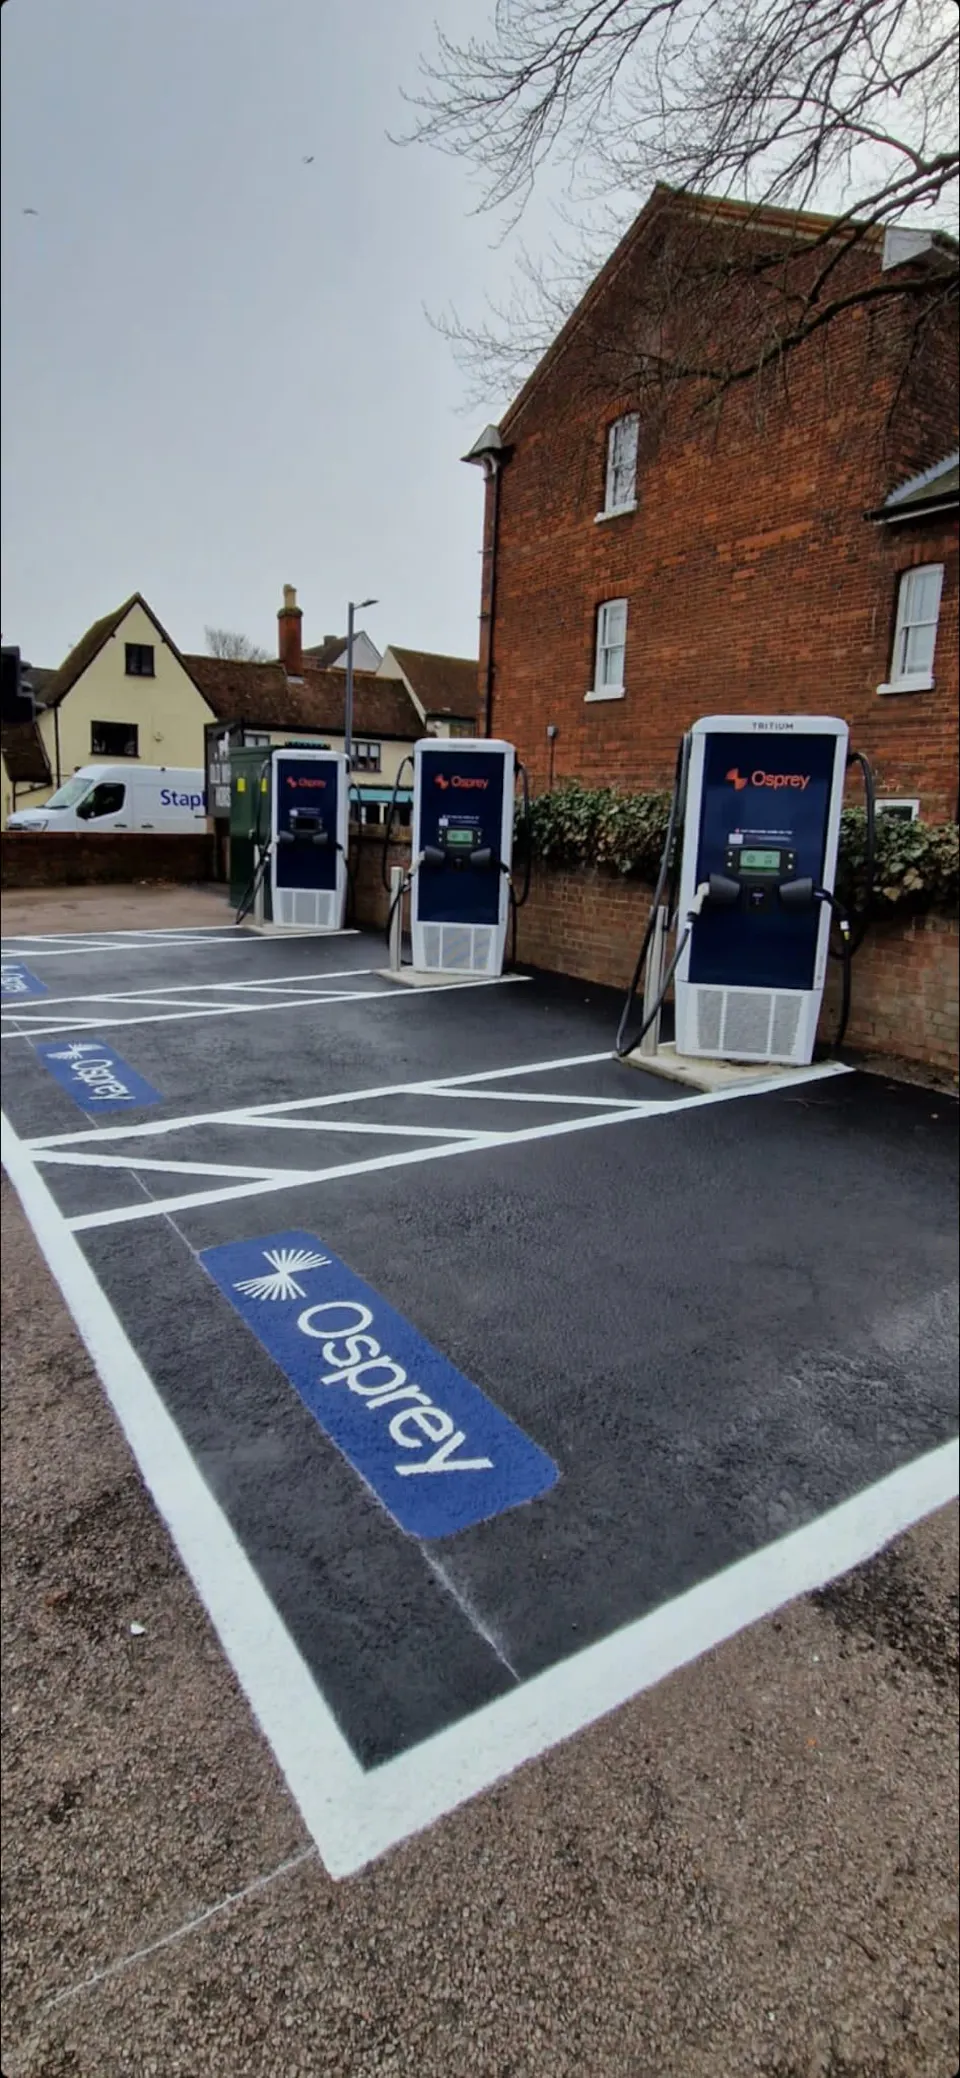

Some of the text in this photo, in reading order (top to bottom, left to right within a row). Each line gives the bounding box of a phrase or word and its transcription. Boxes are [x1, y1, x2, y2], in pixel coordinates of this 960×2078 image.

[752, 722, 794, 731] TRITIUM
[451, 775, 489, 790] Osprey
[751, 770, 811, 790] Osprey
[71, 1058, 136, 1100] Osprey
[297, 1301, 495, 1477] Osprey
